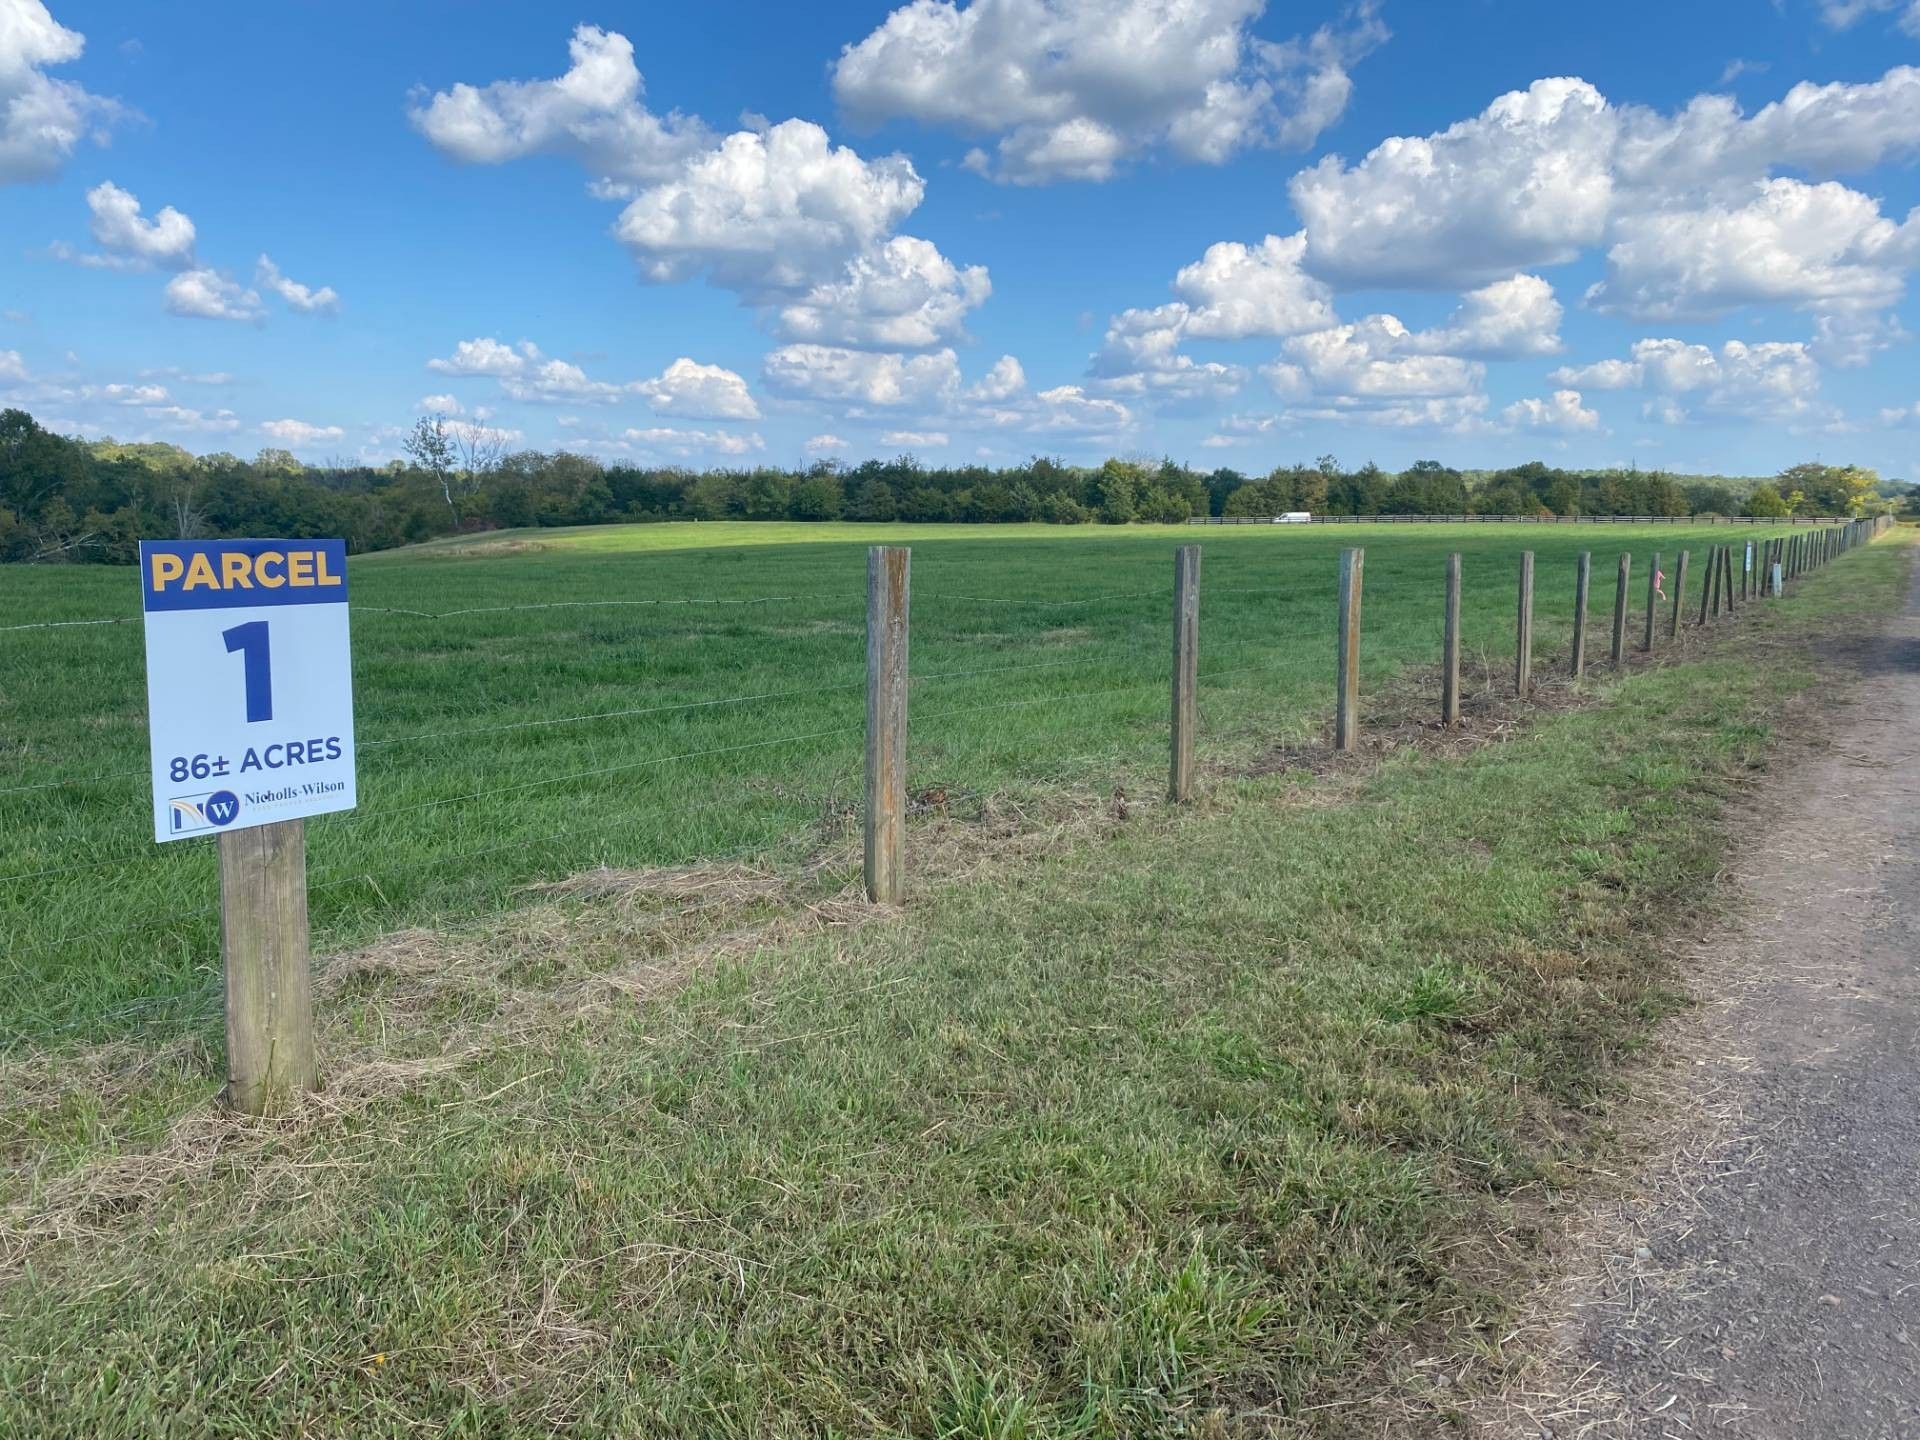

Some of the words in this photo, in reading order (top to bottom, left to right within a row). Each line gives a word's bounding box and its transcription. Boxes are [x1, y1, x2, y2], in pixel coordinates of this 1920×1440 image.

[151, 551, 342, 592] PARCEL
[222, 620, 273, 723] 1
[170, 753, 230, 783] 86±
[240, 736, 342, 773] ACRES
